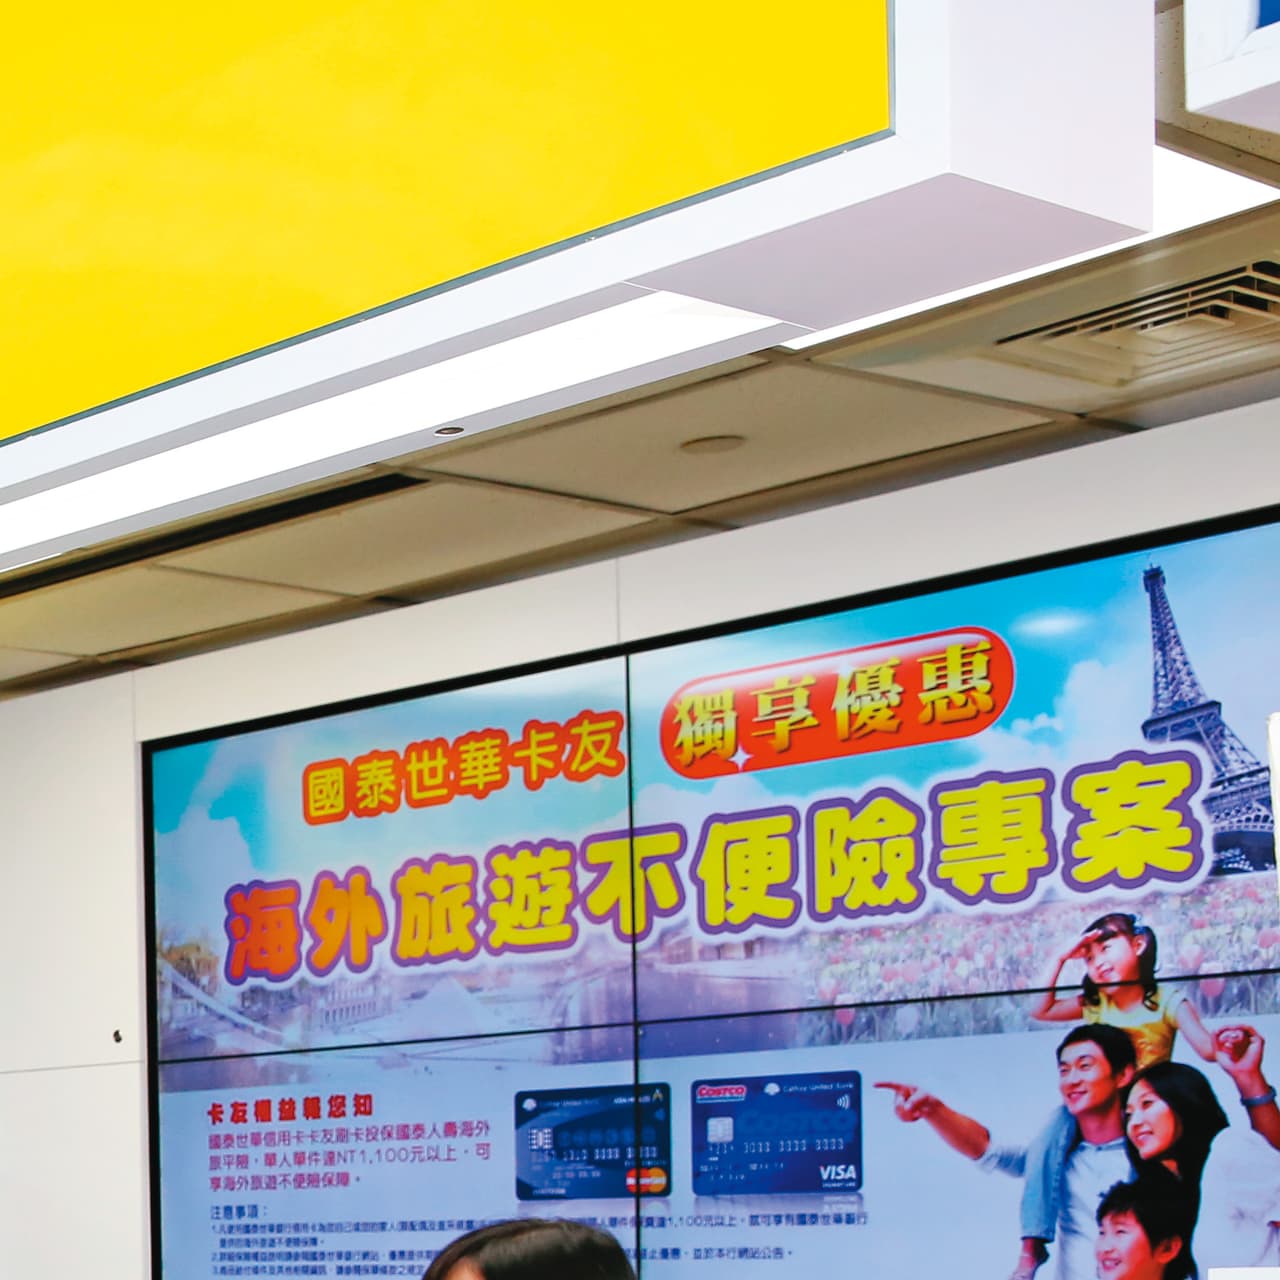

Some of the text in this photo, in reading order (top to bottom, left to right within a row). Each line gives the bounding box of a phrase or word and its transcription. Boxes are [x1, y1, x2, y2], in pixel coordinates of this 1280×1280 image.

[671, 637, 997, 766] 獨享優惠
[304, 711, 627, 825] 國泰世華卡友
[226, 754, 1203, 984] 海外旅遊不便險專案
[819, 1164, 857, 1181] VISA
